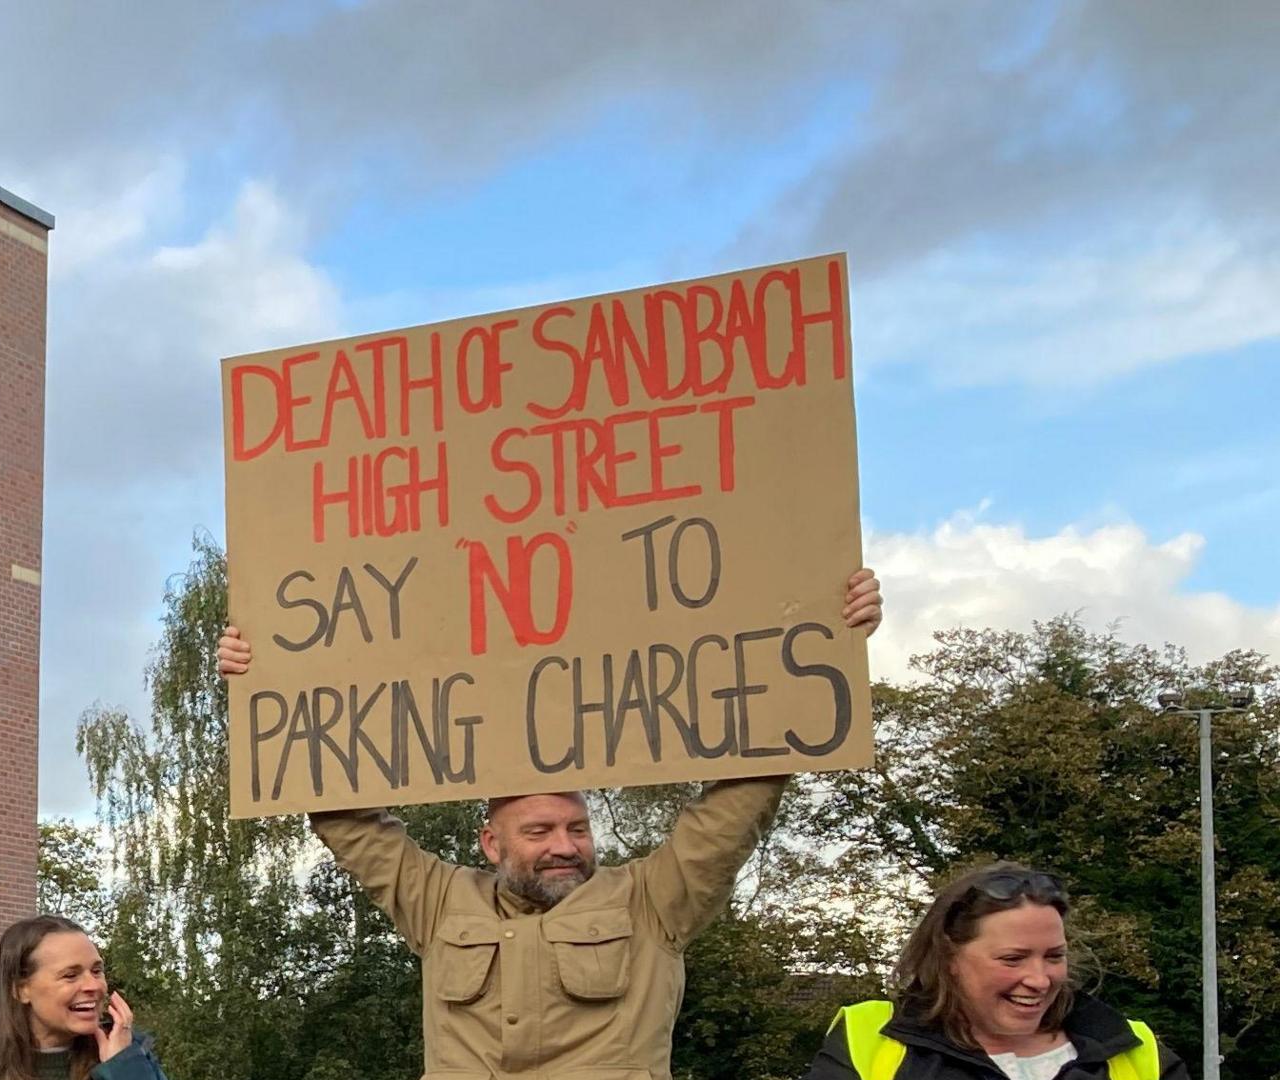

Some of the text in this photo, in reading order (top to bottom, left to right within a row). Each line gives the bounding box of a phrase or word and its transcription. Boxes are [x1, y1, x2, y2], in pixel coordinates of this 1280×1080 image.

[231, 260, 846, 461] DEATH OF SANDBACH
[312, 396, 755, 542] HIGH STREET
[273, 557, 418, 651] SAY
[621, 516, 722, 611] TO
[250, 622, 852, 801] PARKING CHARGES
